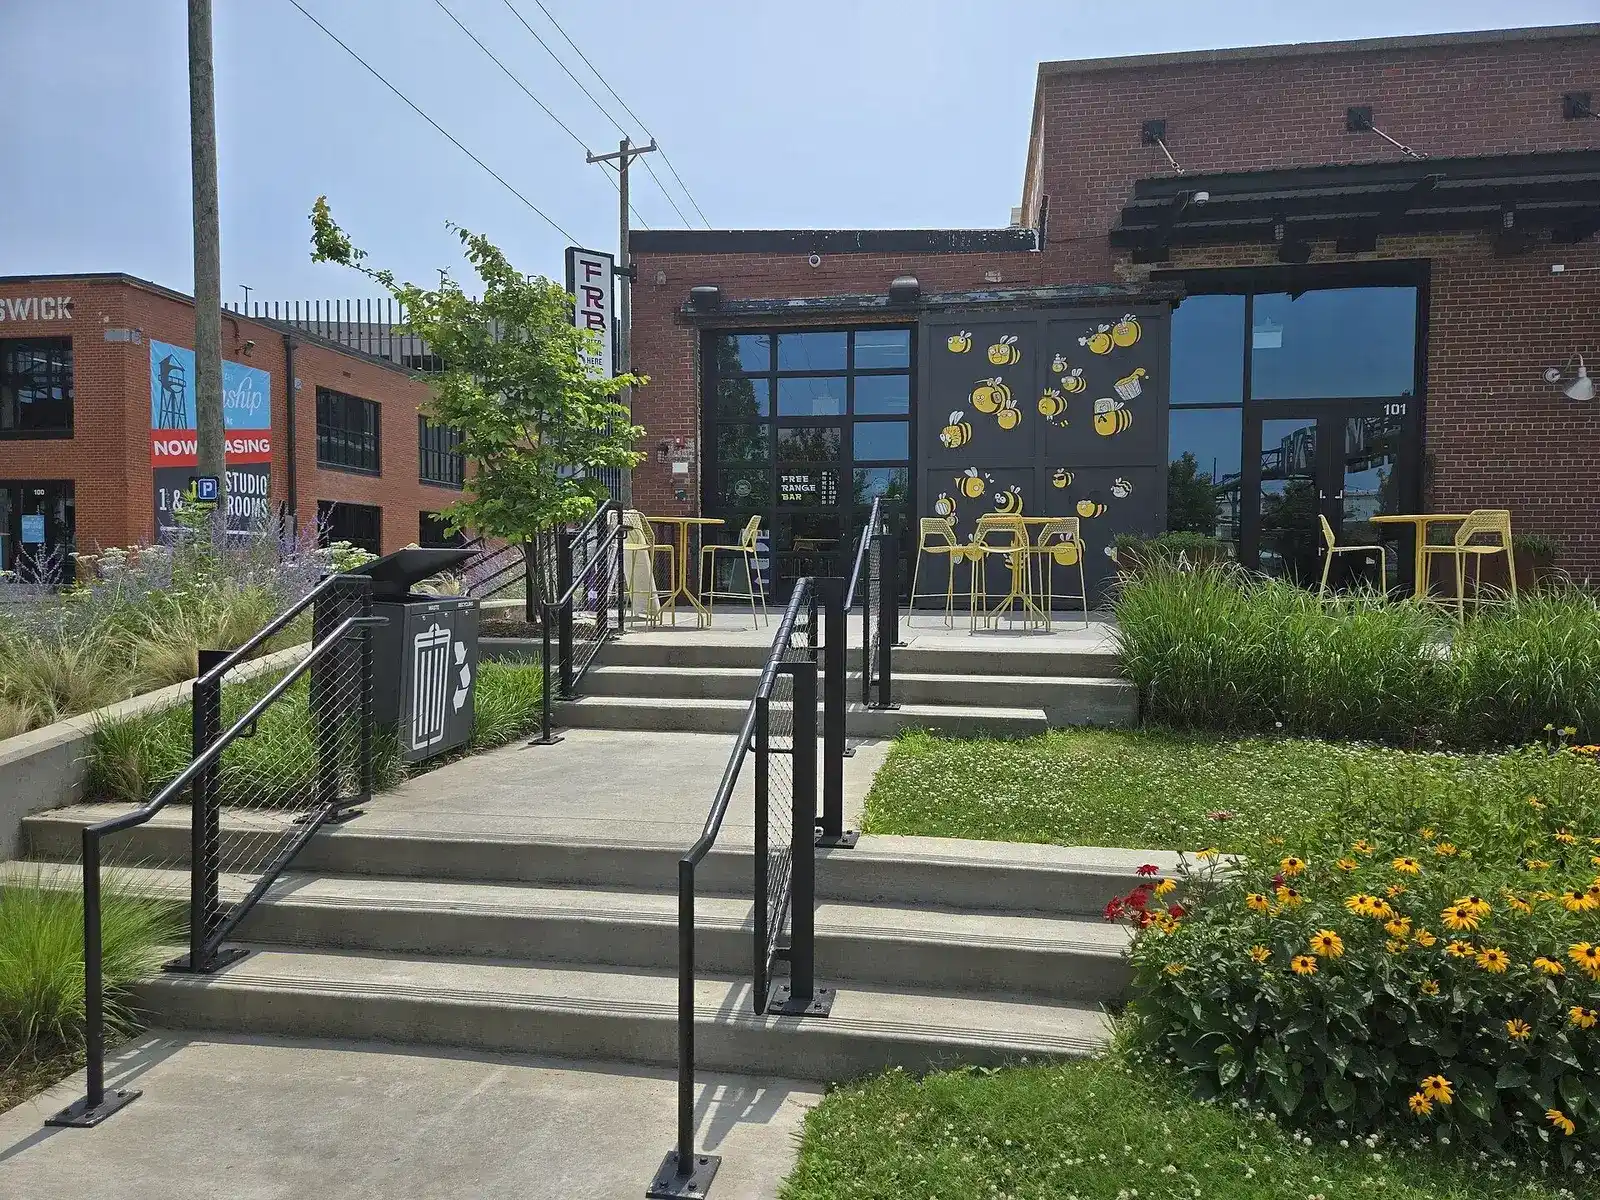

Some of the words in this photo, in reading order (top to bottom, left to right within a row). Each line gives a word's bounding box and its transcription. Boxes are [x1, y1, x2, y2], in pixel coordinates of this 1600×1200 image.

[223, 377, 262, 416] ship
[1383, 403, 1406, 415] 101
[154, 440, 198, 456] NOW
[225, 439, 270, 454] ASING
[225, 471, 268, 496] STUDIO
[781, 475, 809, 483] FREE
[203, 482, 213, 496] P
[781, 484, 816, 492] RANGE
[159, 488, 167, 511] 1
[172, 489, 184, 512] &
[227, 495, 269, 518] ROOMS
[781, 493, 802, 501] BAR
